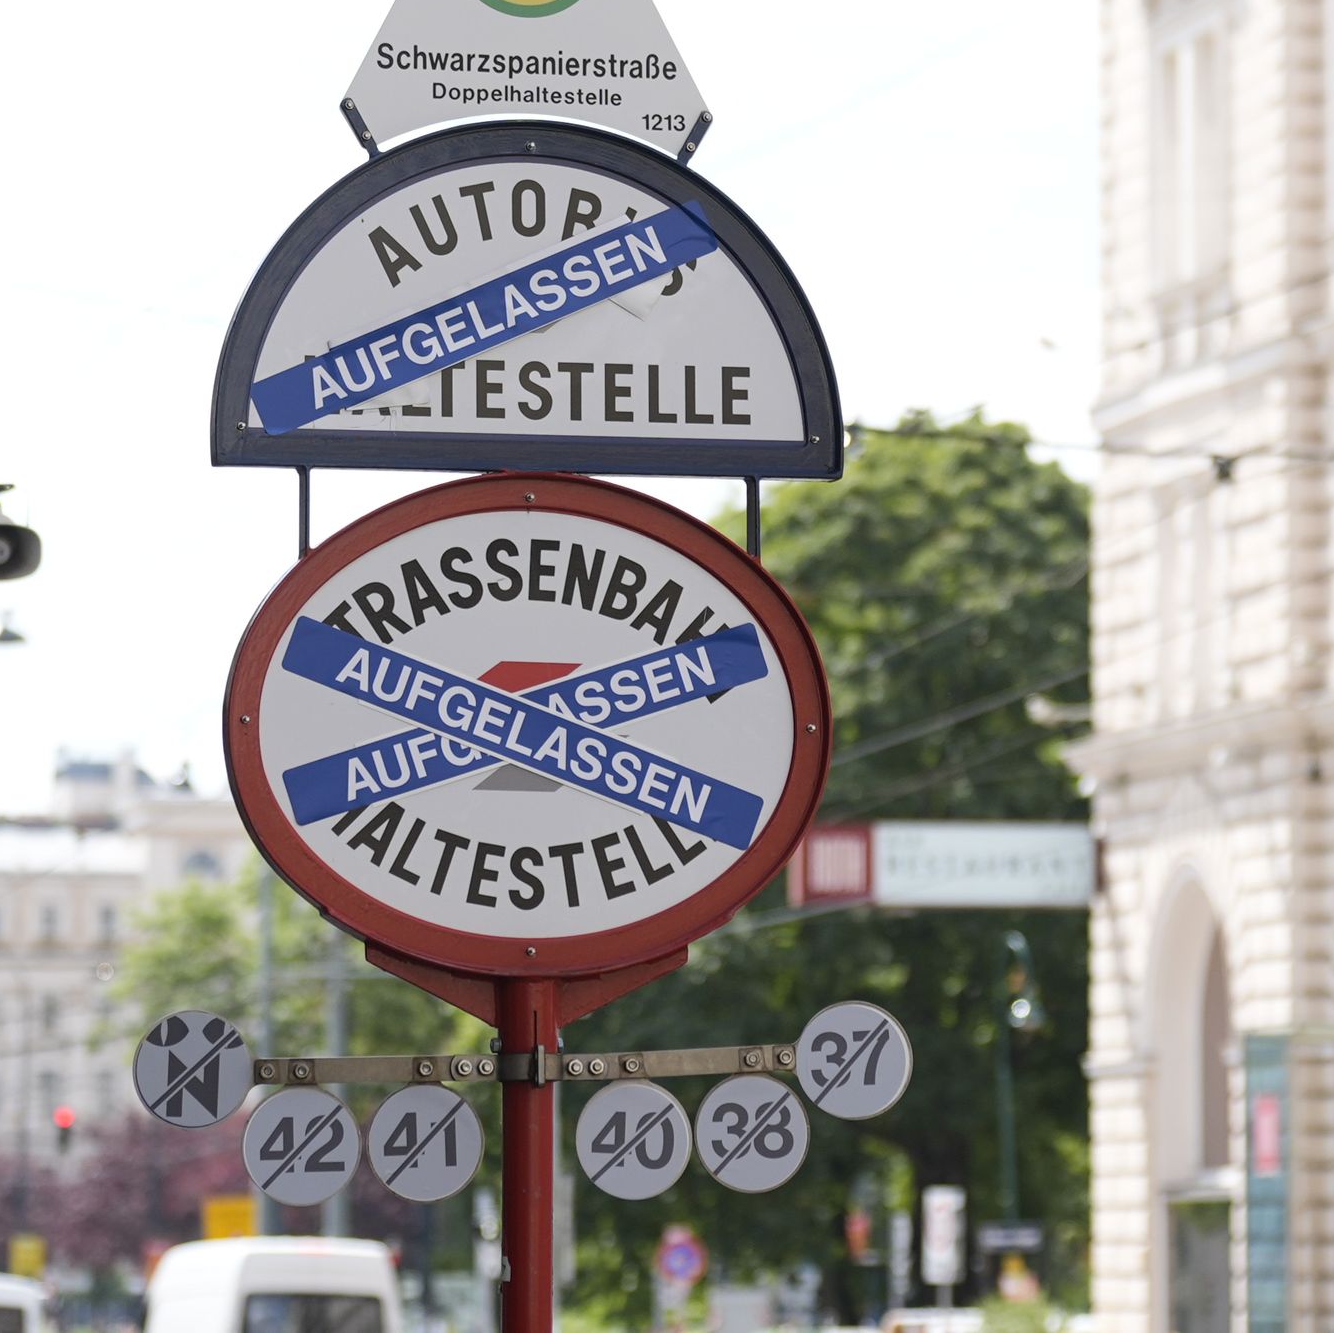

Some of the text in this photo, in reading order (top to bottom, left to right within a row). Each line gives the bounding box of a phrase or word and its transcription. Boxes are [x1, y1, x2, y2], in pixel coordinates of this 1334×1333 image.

[376, 42, 677, 80] Schwarzspanierstraße
[432, 82, 622, 106] Doppelhaltestelle
[642, 114, 686, 132] 1213
[310, 226, 668, 410] AUFGELASSEN
[334, 647, 712, 823] AUFGELASSEN
[165, 1049, 221, 1120] N
[810, 1028, 891, 1089] 37
[259, 1113, 346, 1174] 42
[383, 1111, 458, 1169] 41
[590, 1110, 675, 1170] 40
[710, 1101, 795, 1161] 38
